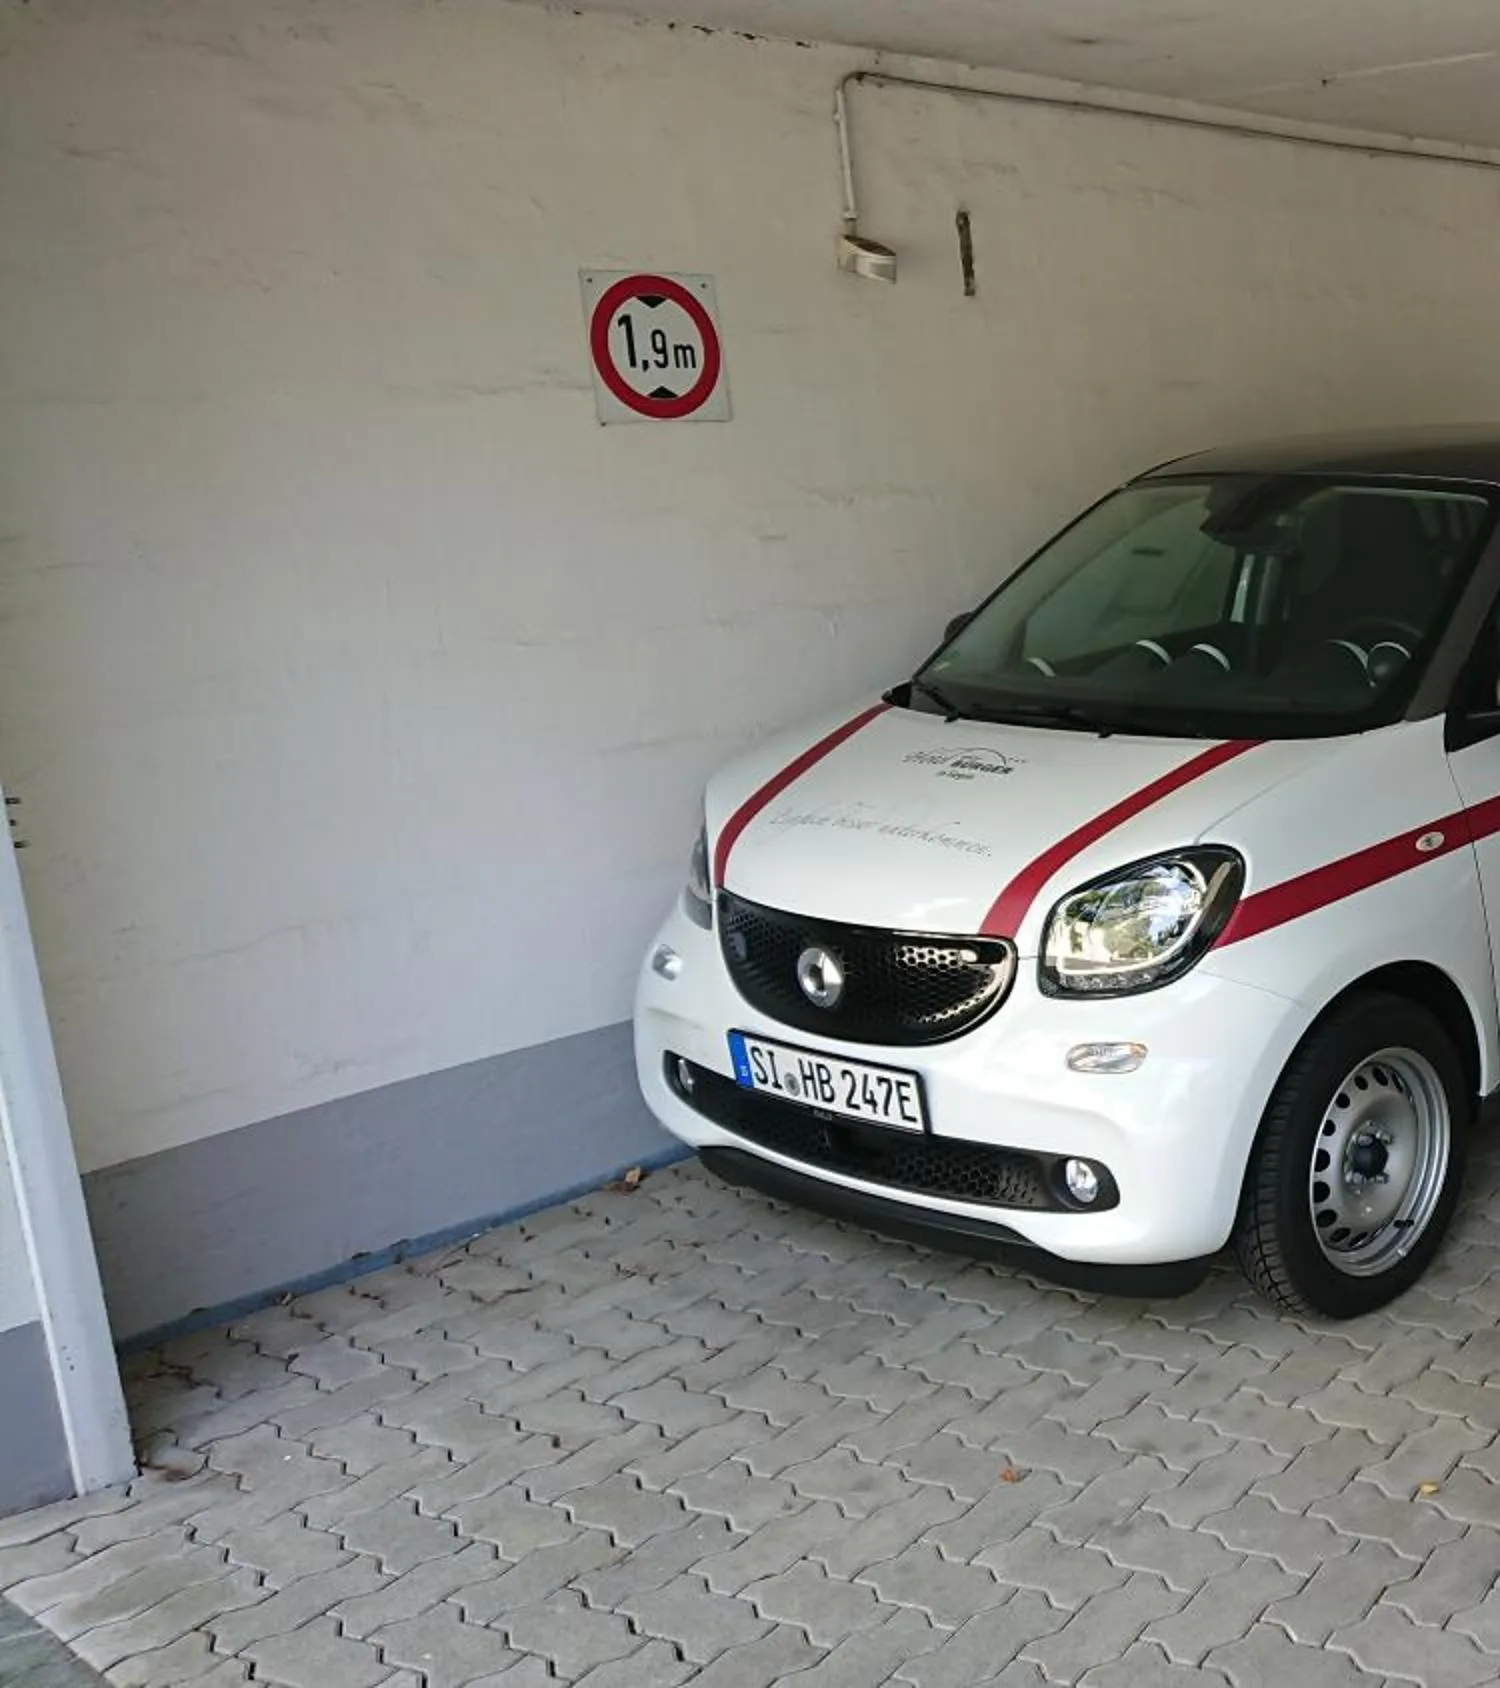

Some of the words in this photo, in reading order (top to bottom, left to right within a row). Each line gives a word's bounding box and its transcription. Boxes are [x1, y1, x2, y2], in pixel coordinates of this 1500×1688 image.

[751, 1046, 783, 1090] SI
[798, 1058, 836, 1104] HB
[841, 1069, 918, 1122] 247E
